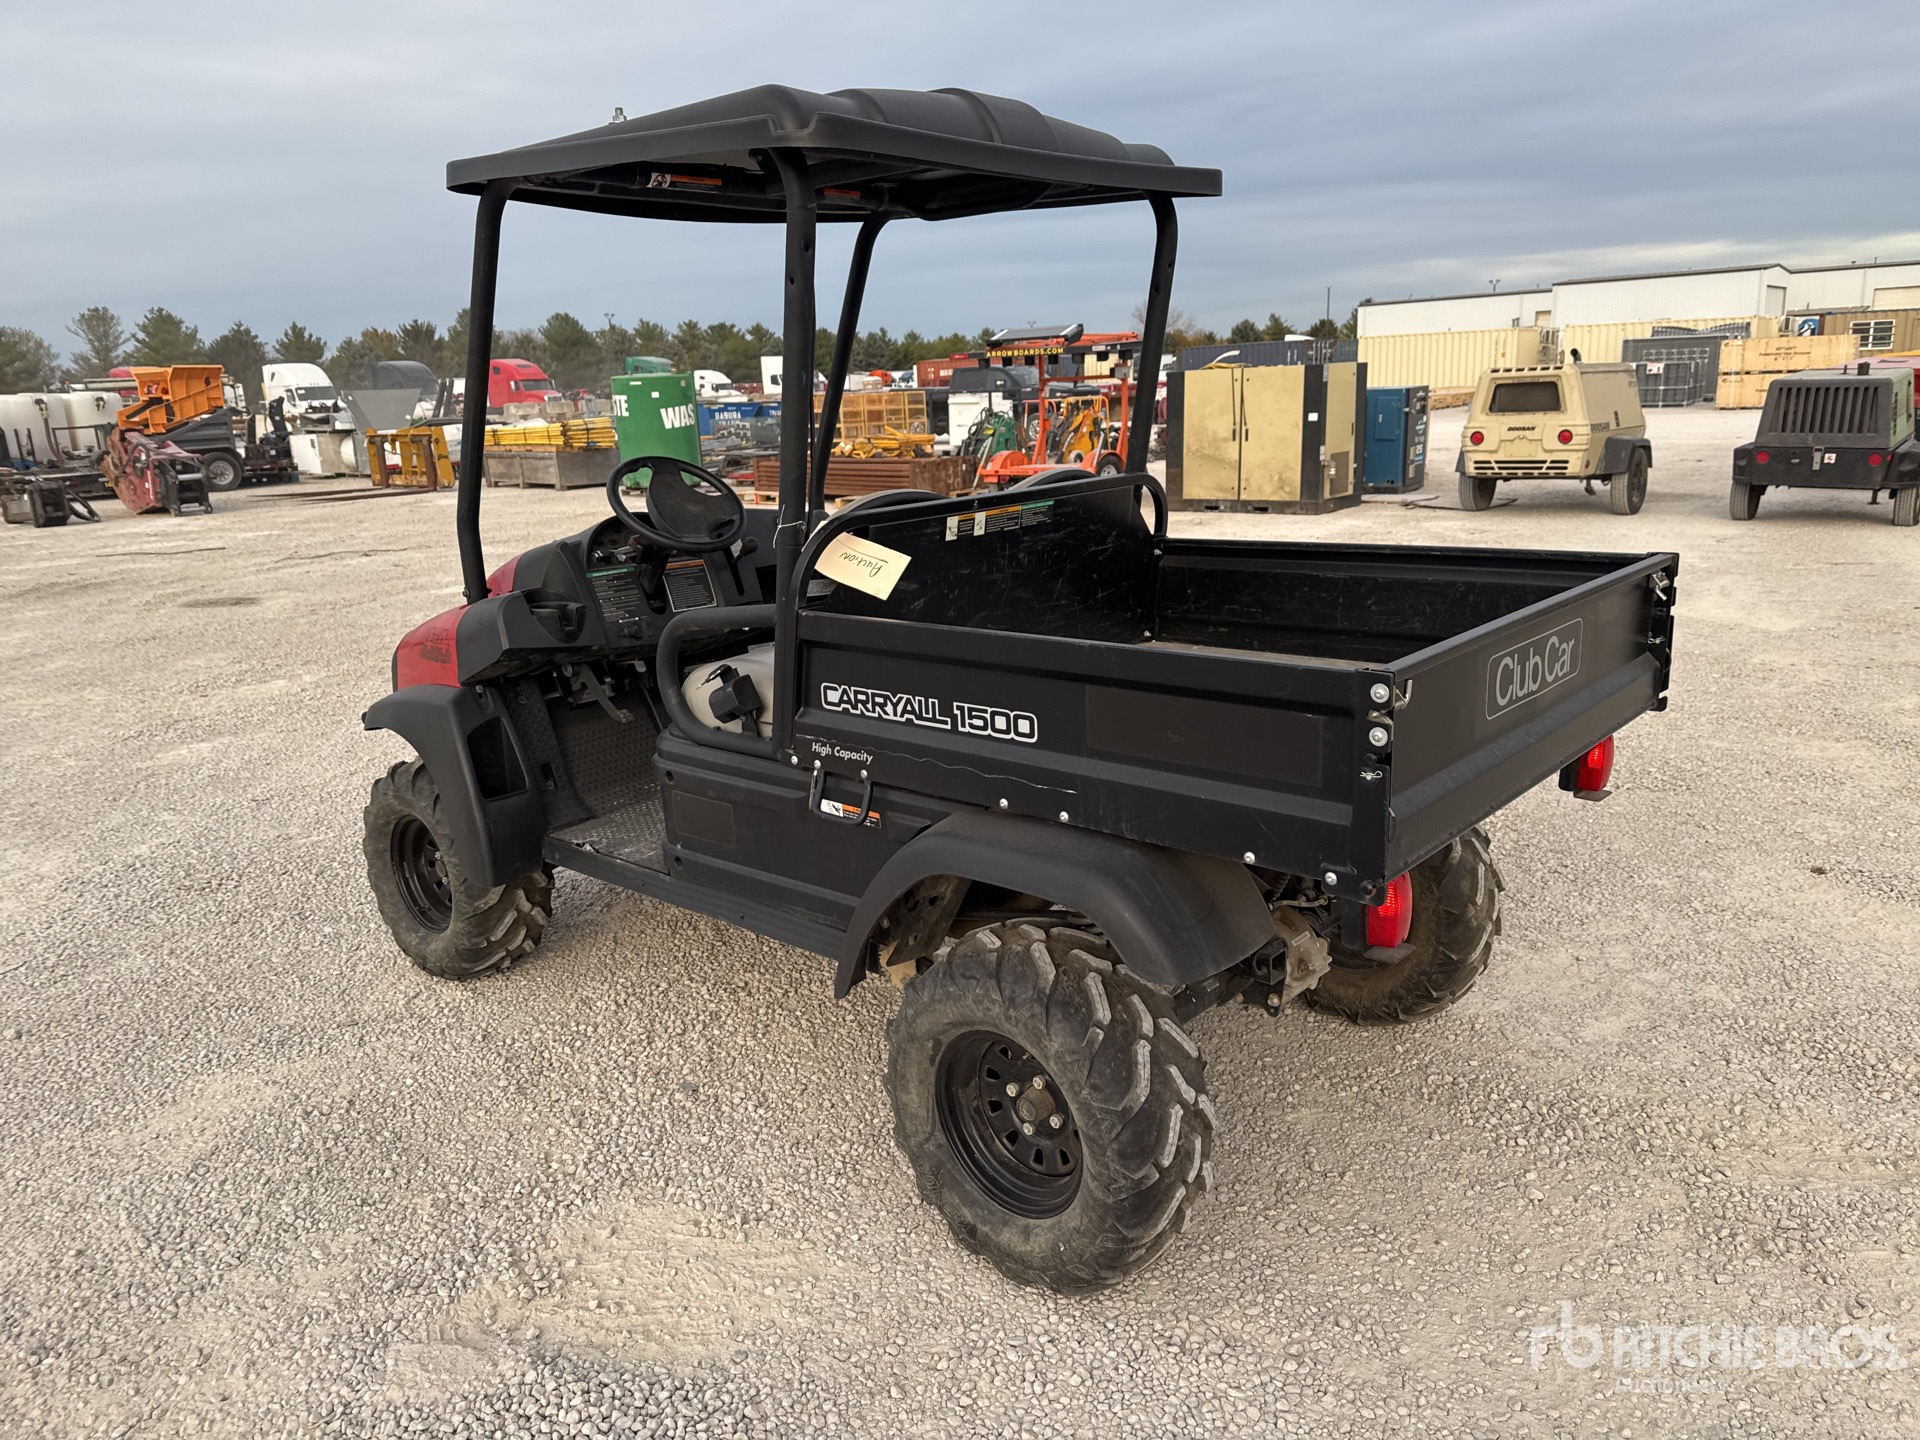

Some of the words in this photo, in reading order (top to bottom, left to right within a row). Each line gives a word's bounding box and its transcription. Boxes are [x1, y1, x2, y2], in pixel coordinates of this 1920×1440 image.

[986, 347, 1064, 358] ARROWBOARDS.COM
[660, 403, 696, 430] WAS
[1495, 647, 1543, 707] Club
[1544, 635, 1575, 683] Car
[820, 682, 951, 730] CARRYALL
[953, 701, 1038, 743] 1500
[811, 742, 832, 757] High
[834, 746, 874, 765] Capacity
